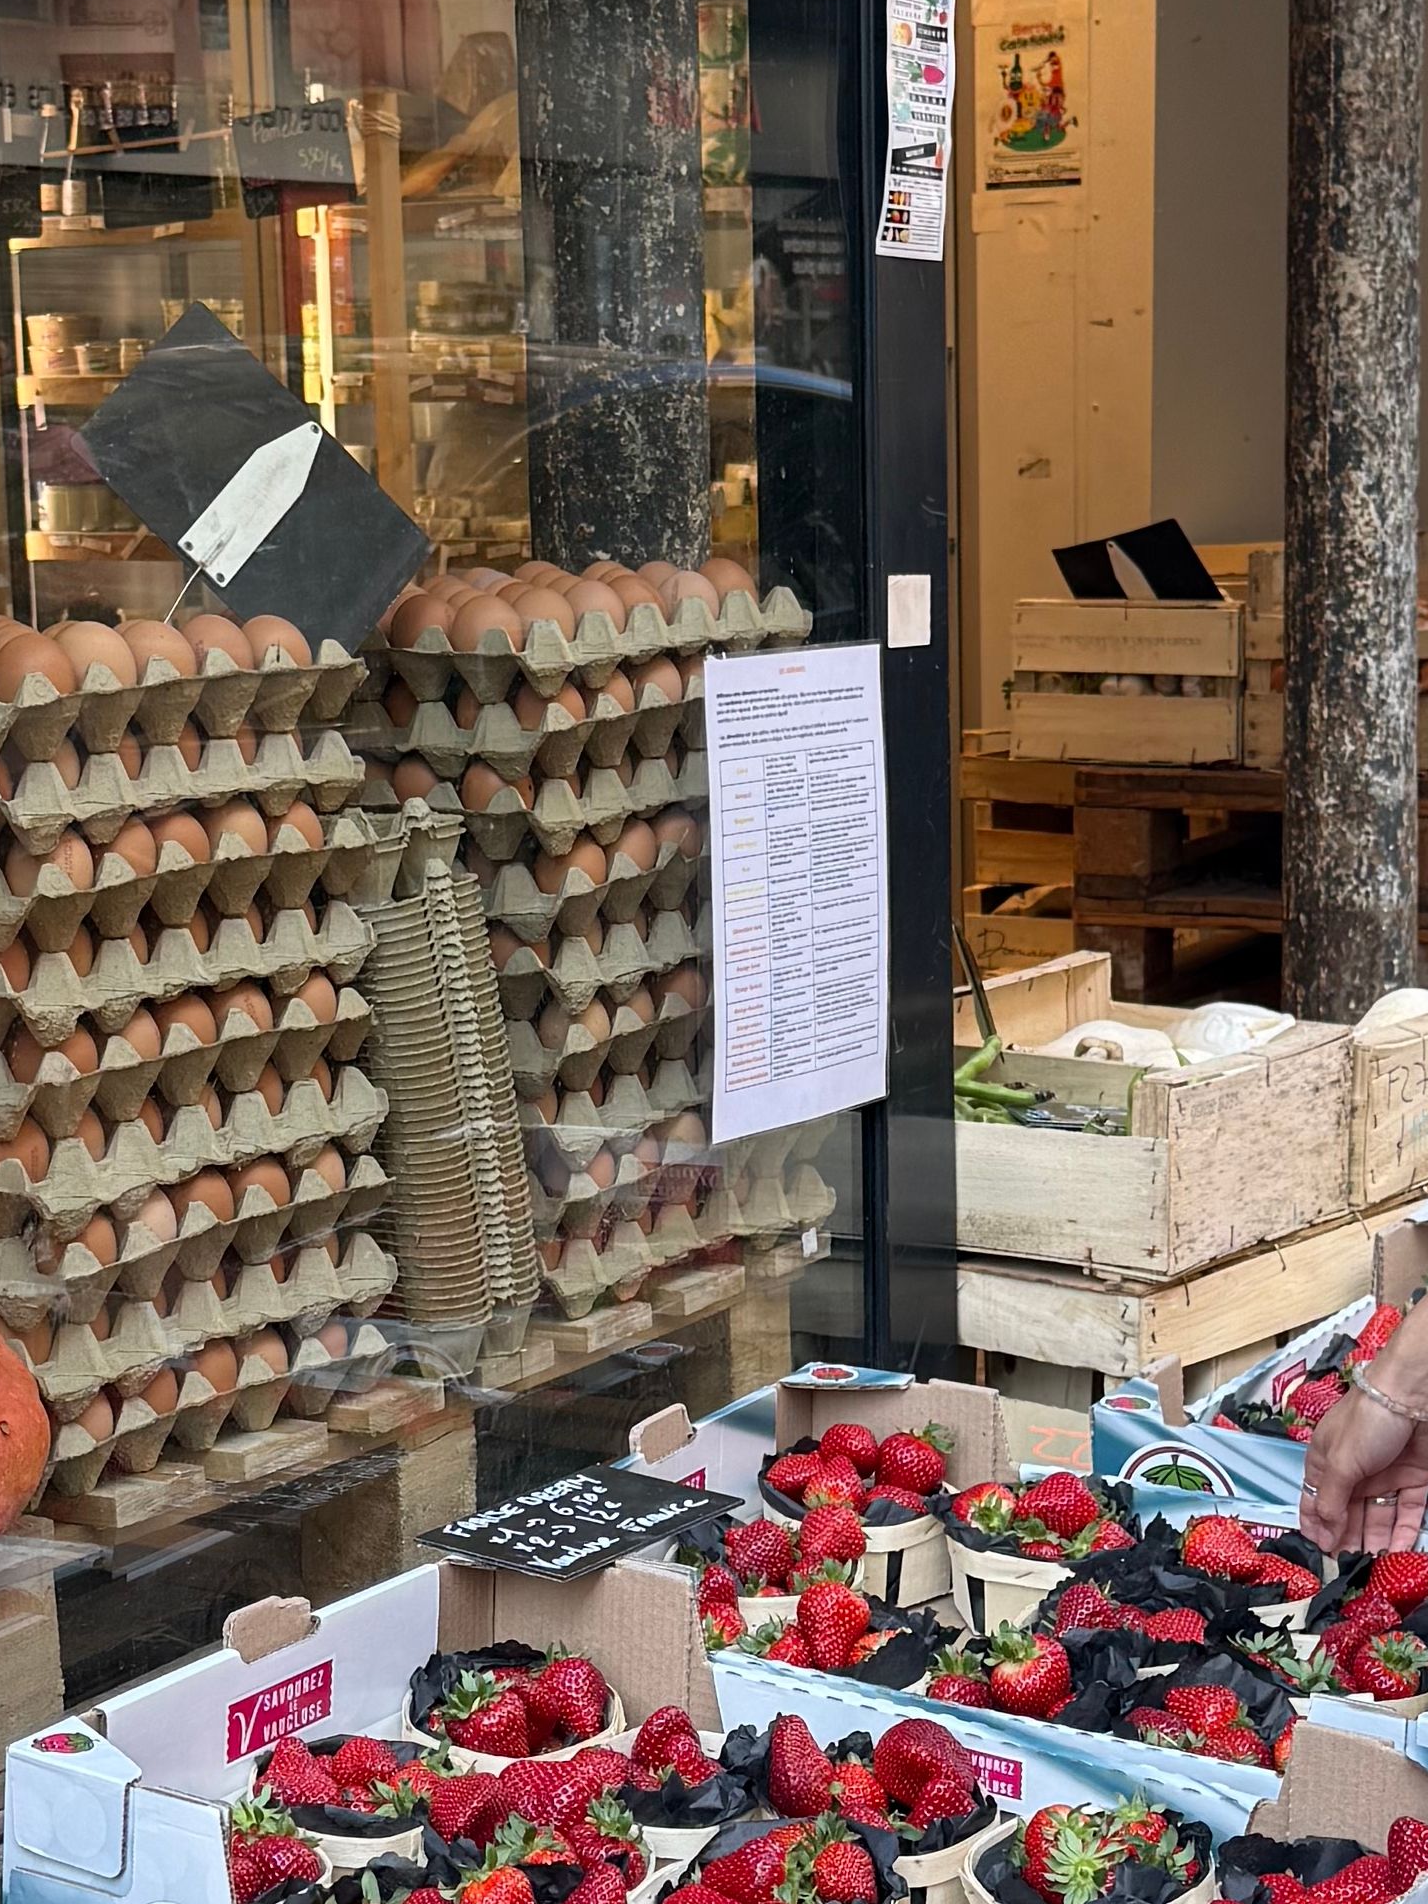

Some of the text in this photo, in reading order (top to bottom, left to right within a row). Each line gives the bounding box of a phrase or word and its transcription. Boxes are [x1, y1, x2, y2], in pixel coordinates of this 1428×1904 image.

[263, 1669, 324, 1713] SAVOUREZ
[262, 1699, 323, 1743] VAUCLUSE
[971, 1753, 1015, 1776] VOUREZ
[978, 1776, 1015, 1797] CLUSE
